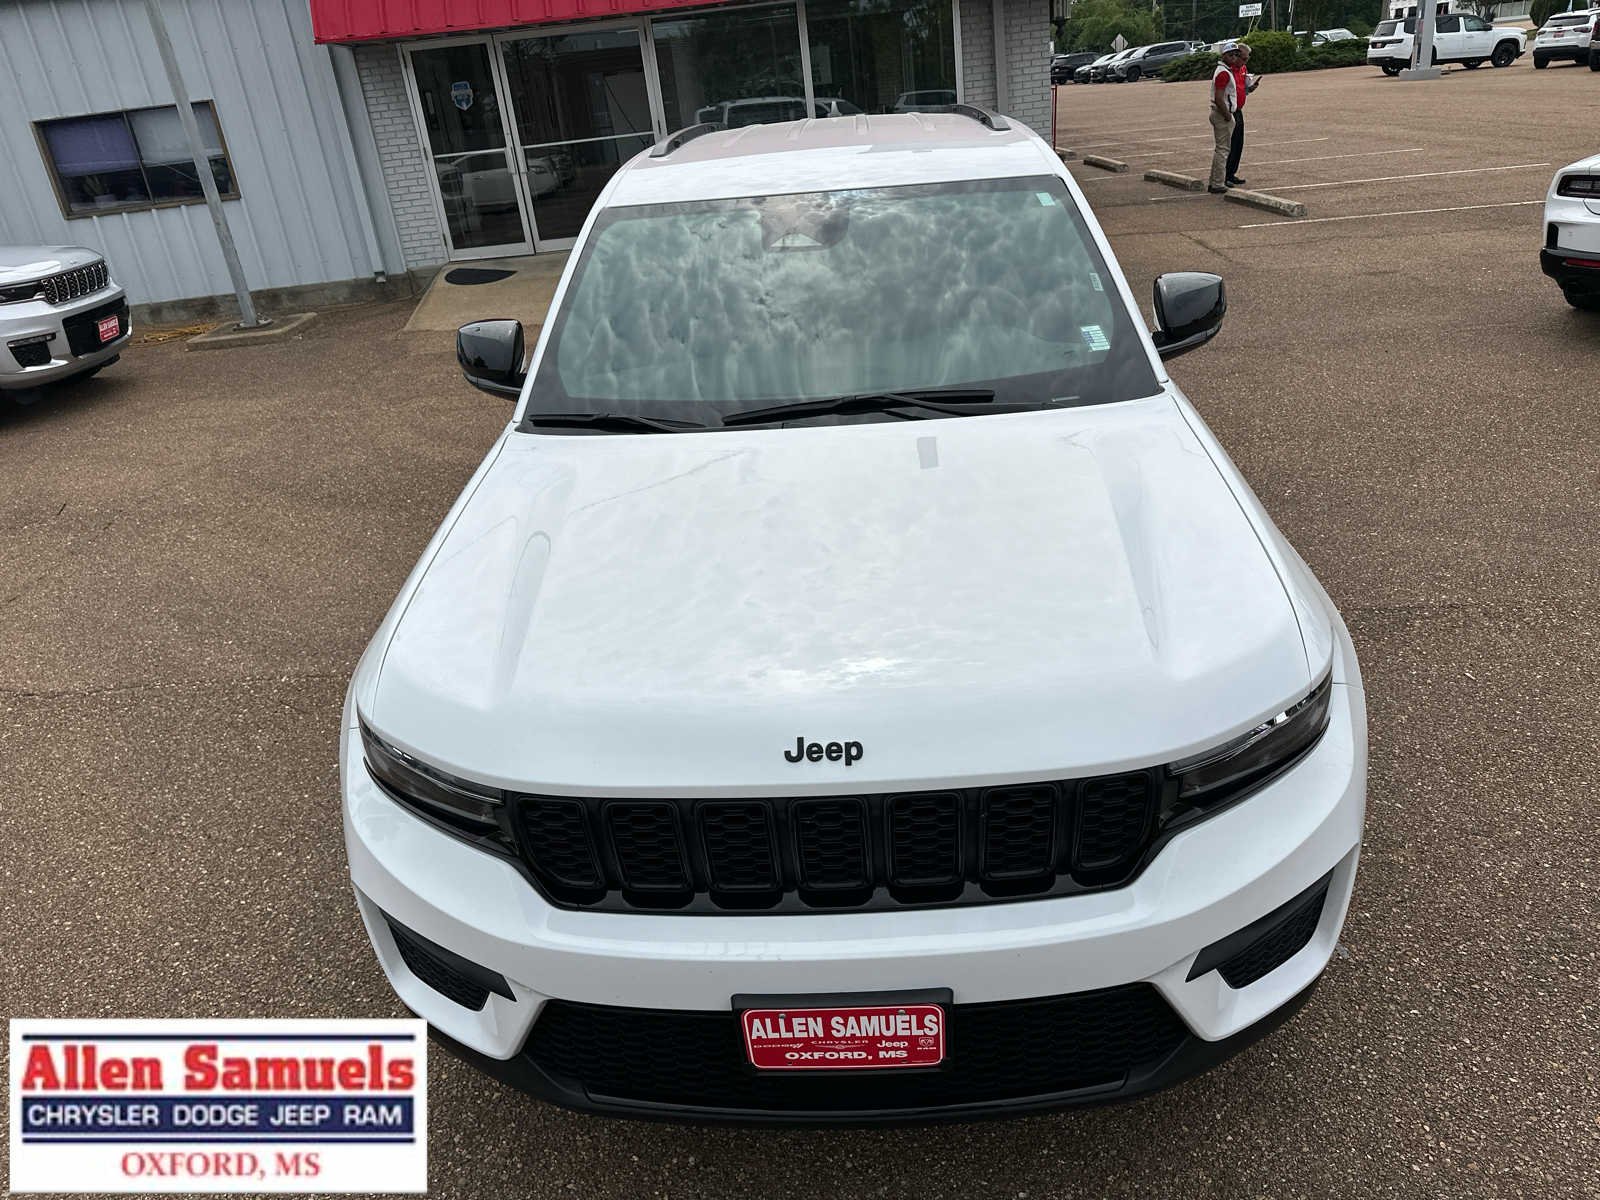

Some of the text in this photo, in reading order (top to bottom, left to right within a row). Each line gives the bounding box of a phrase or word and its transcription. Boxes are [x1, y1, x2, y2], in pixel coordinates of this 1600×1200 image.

[783, 736, 864, 766] Jeep
[751, 1014, 939, 1039] ALLEN SAMUELS
[876, 1040, 909, 1049] Jeep
[785, 1050, 908, 1061] OXFORD, MS
